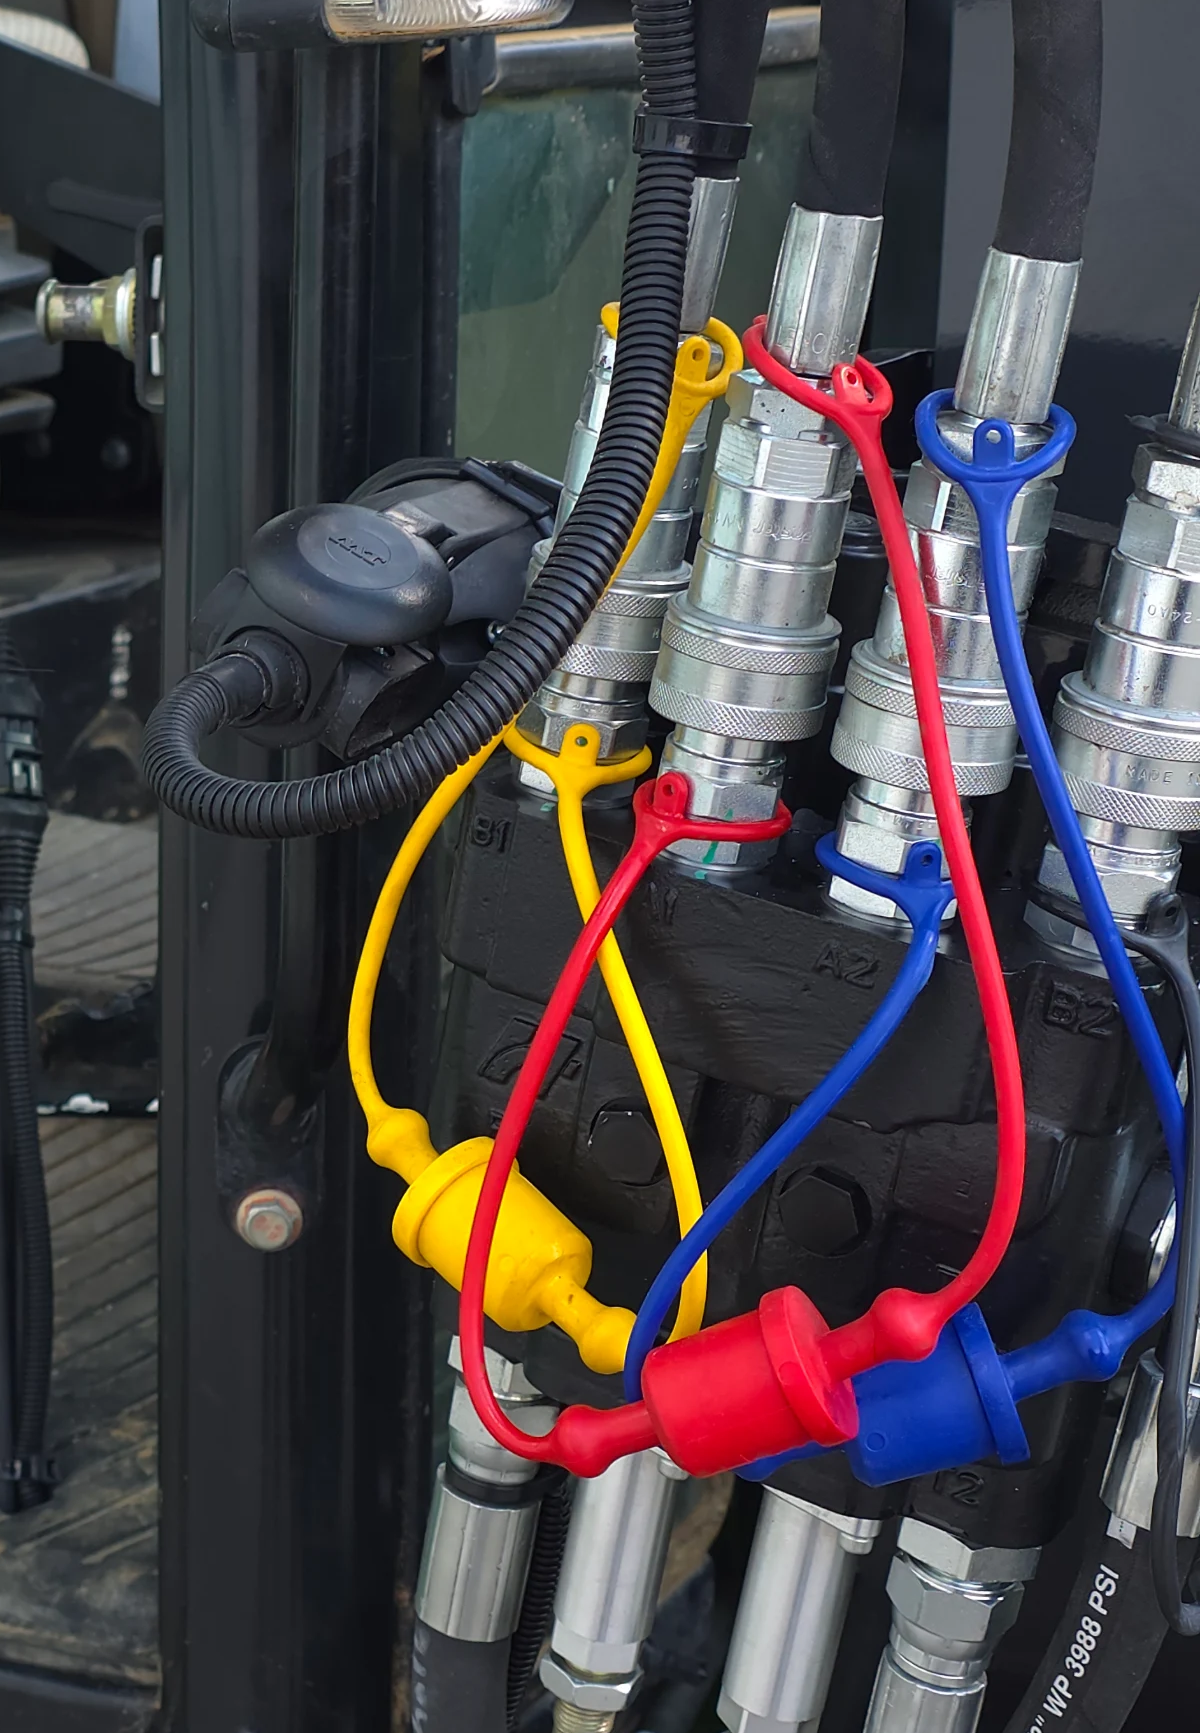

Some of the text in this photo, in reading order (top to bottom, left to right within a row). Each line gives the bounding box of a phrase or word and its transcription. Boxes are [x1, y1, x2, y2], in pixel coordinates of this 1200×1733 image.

[1125, 764, 1174, 786] MADE
[471, 814, 512, 854] B1
[812, 939, 881, 990] A2
[1042, 979, 1120, 1039] B2
[1042, 1673, 1073, 1719] WP
[1064, 1615, 1103, 1679] 3988
[1086, 1563, 1120, 1616] PSI
